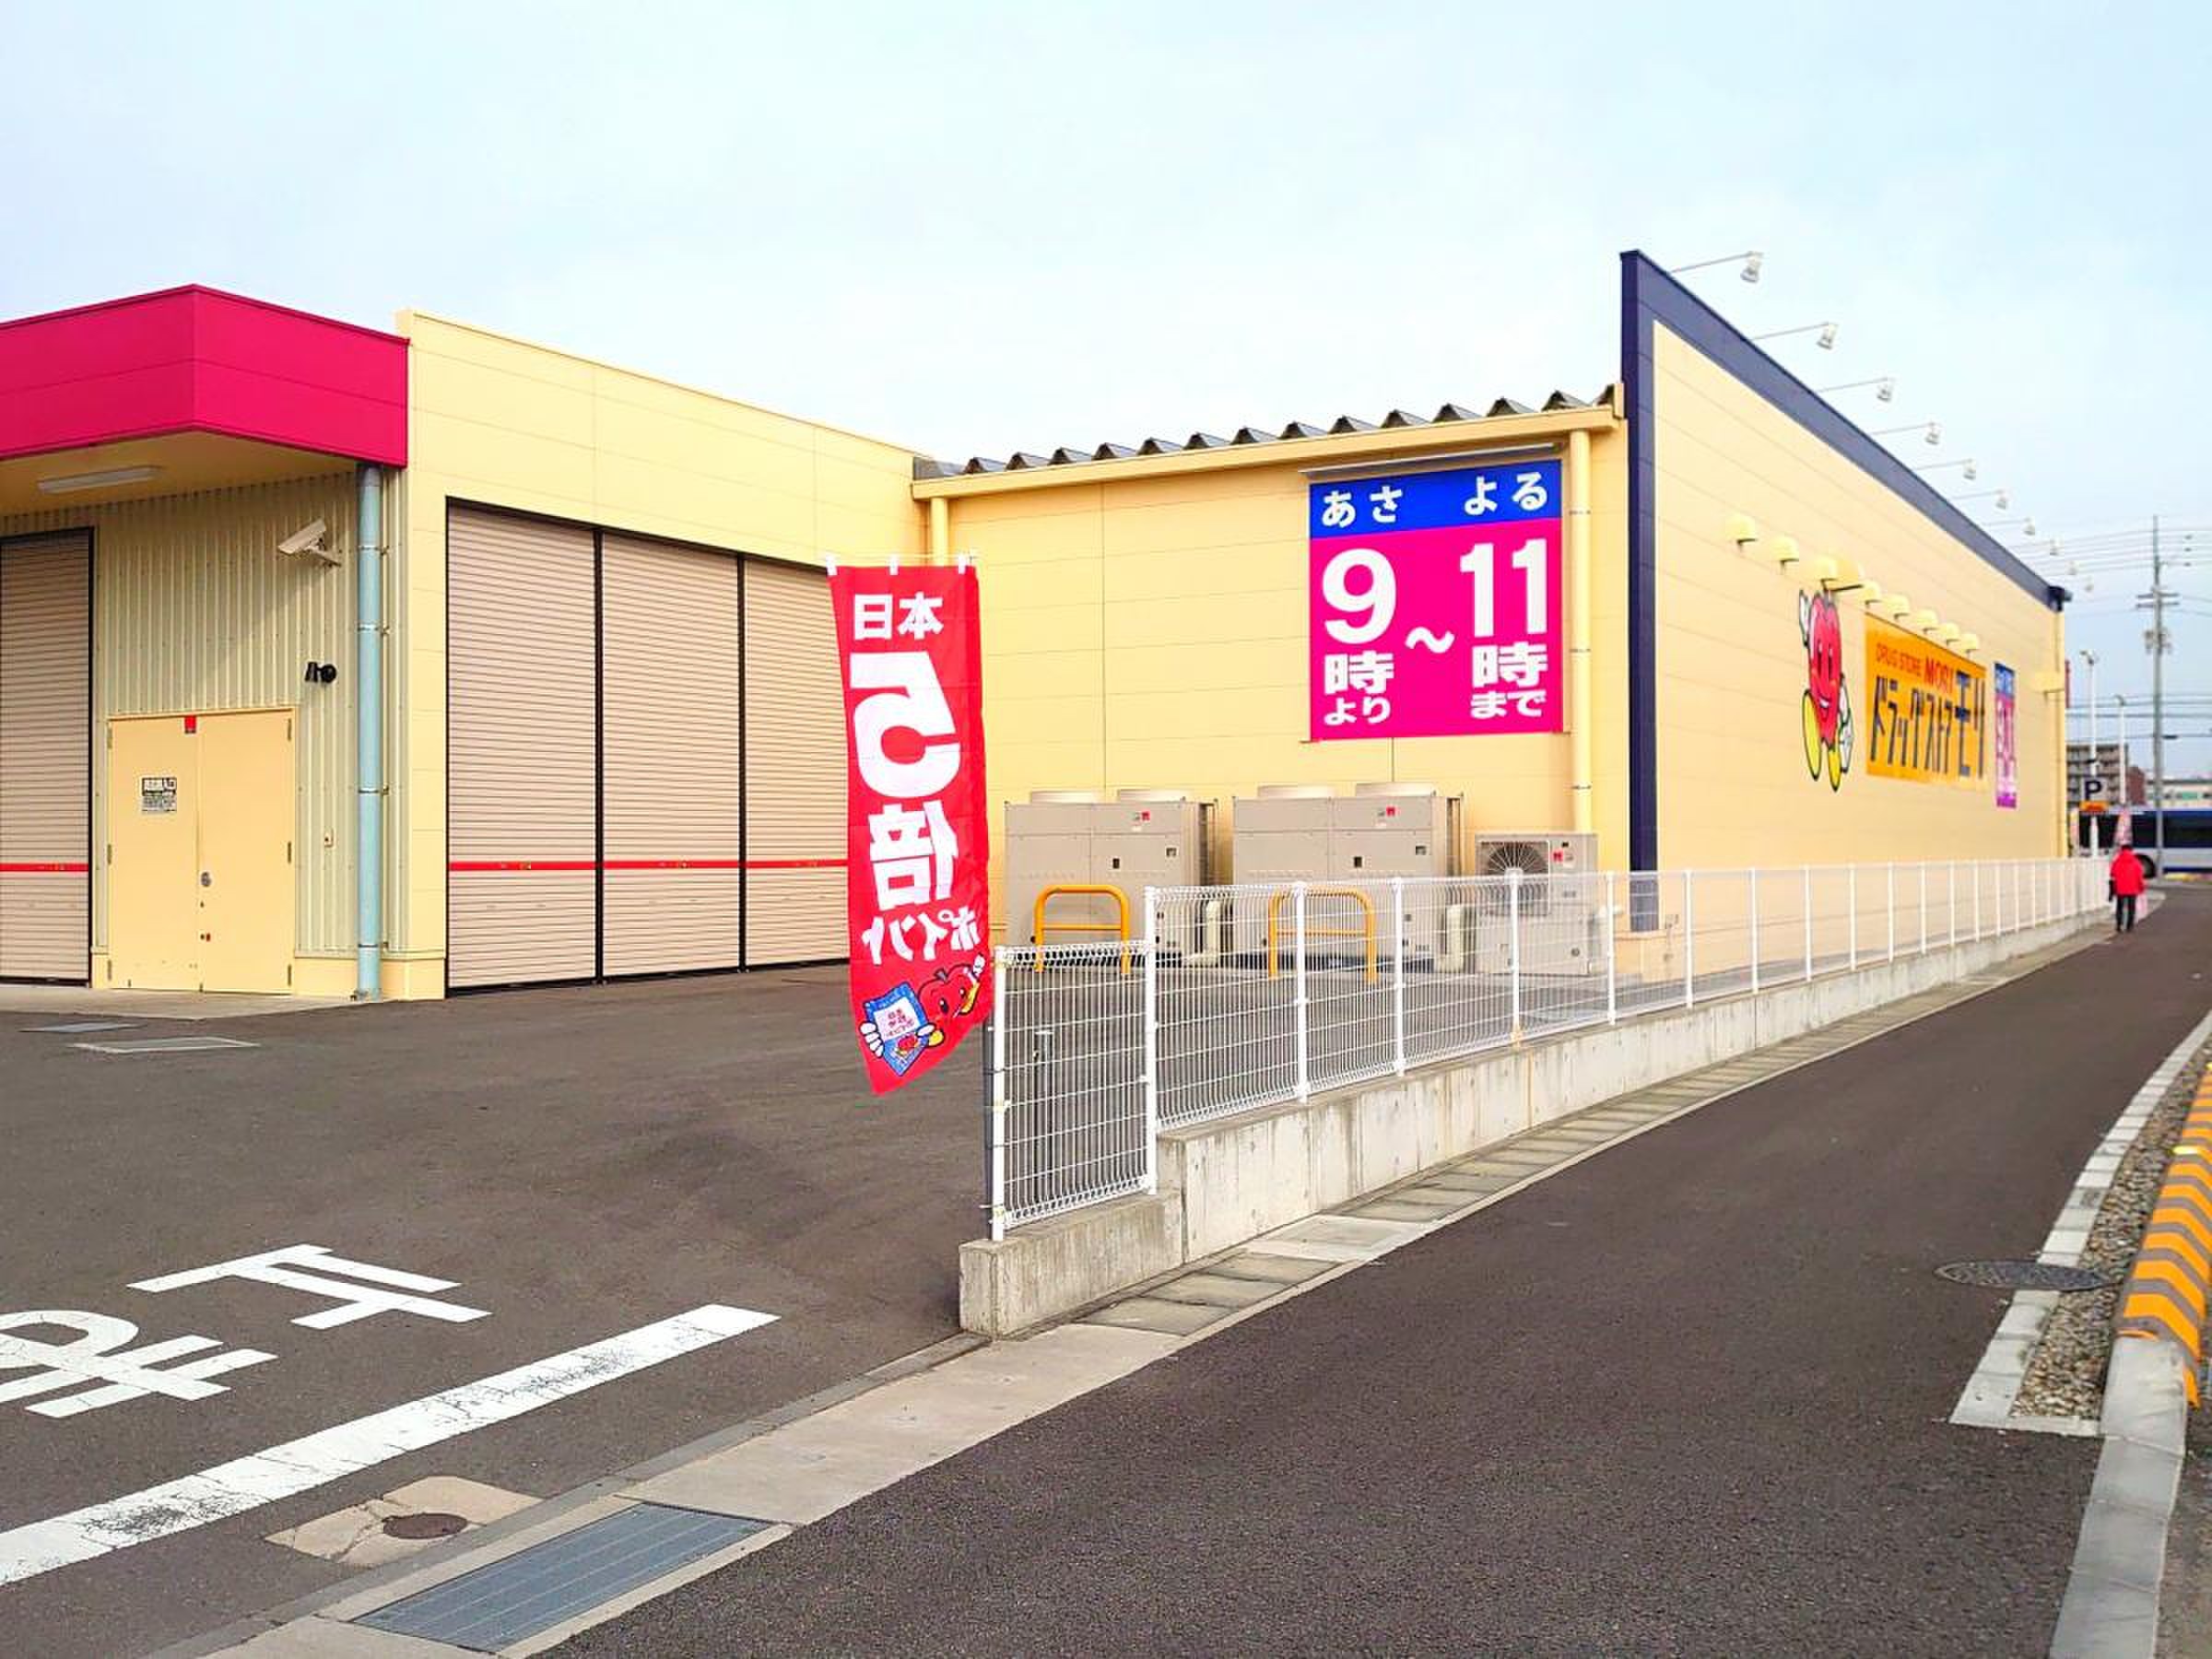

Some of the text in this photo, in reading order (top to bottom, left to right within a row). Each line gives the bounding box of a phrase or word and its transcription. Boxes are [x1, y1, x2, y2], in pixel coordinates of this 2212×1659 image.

[1322, 472, 1547, 527] あさ よる
[1324, 689, 1547, 725] より まで
[2085, 780, 2102, 800] P
